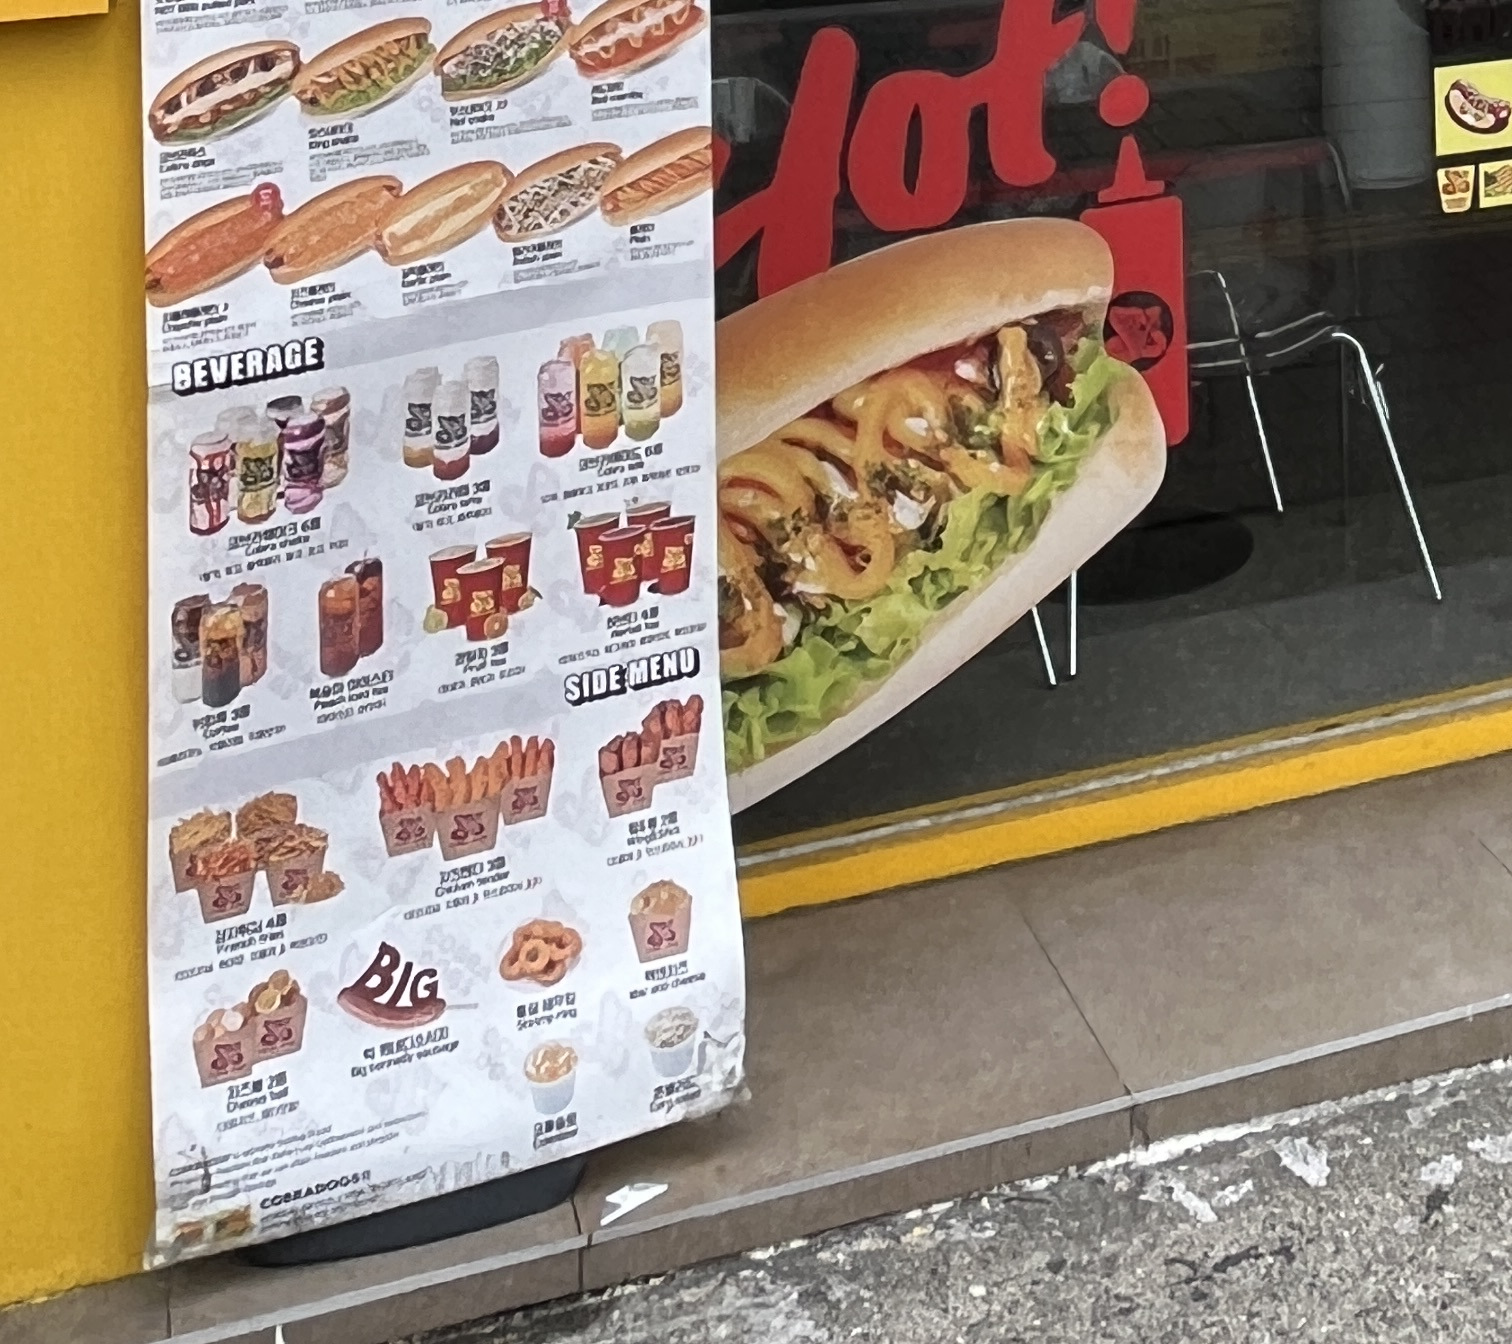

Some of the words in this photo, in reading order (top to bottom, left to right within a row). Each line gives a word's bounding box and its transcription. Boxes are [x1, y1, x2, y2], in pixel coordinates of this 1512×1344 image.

[172, 337, 324, 397] BEVERAGE
[564, 662, 626, 706] SIDE
[627, 647, 700, 692] MENU
[353, 941, 439, 1008] BIG
